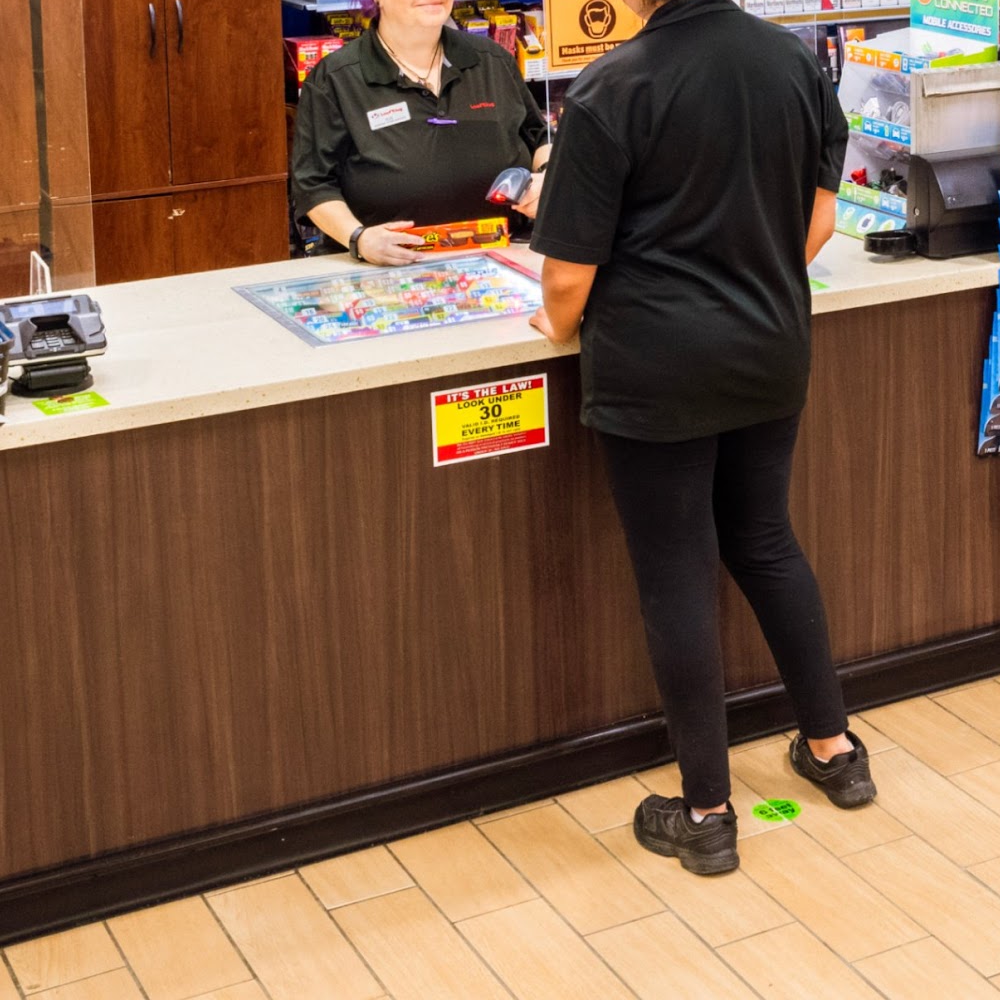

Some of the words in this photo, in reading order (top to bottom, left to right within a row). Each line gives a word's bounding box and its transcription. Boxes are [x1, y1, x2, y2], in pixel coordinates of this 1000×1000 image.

[922, 15, 946, 28] MOBILE
[948, 19, 992, 36] ACCESSORIES
[561, 46, 585, 56] Masks
[586, 44, 604, 54] must
[605, 42, 615, 52] be
[447, 391, 470, 402] IT'S
[474, 387, 497, 398] THE
[502, 381, 532, 393] LAW!
[457, 400, 485, 410] LOOK
[488, 393, 522, 403] UNDER
[479, 404, 502, 420] 30
[491, 415, 520, 423] REQUIRED
[462, 426, 494, 437] EVERY
[497, 420, 520, 430] TIME
